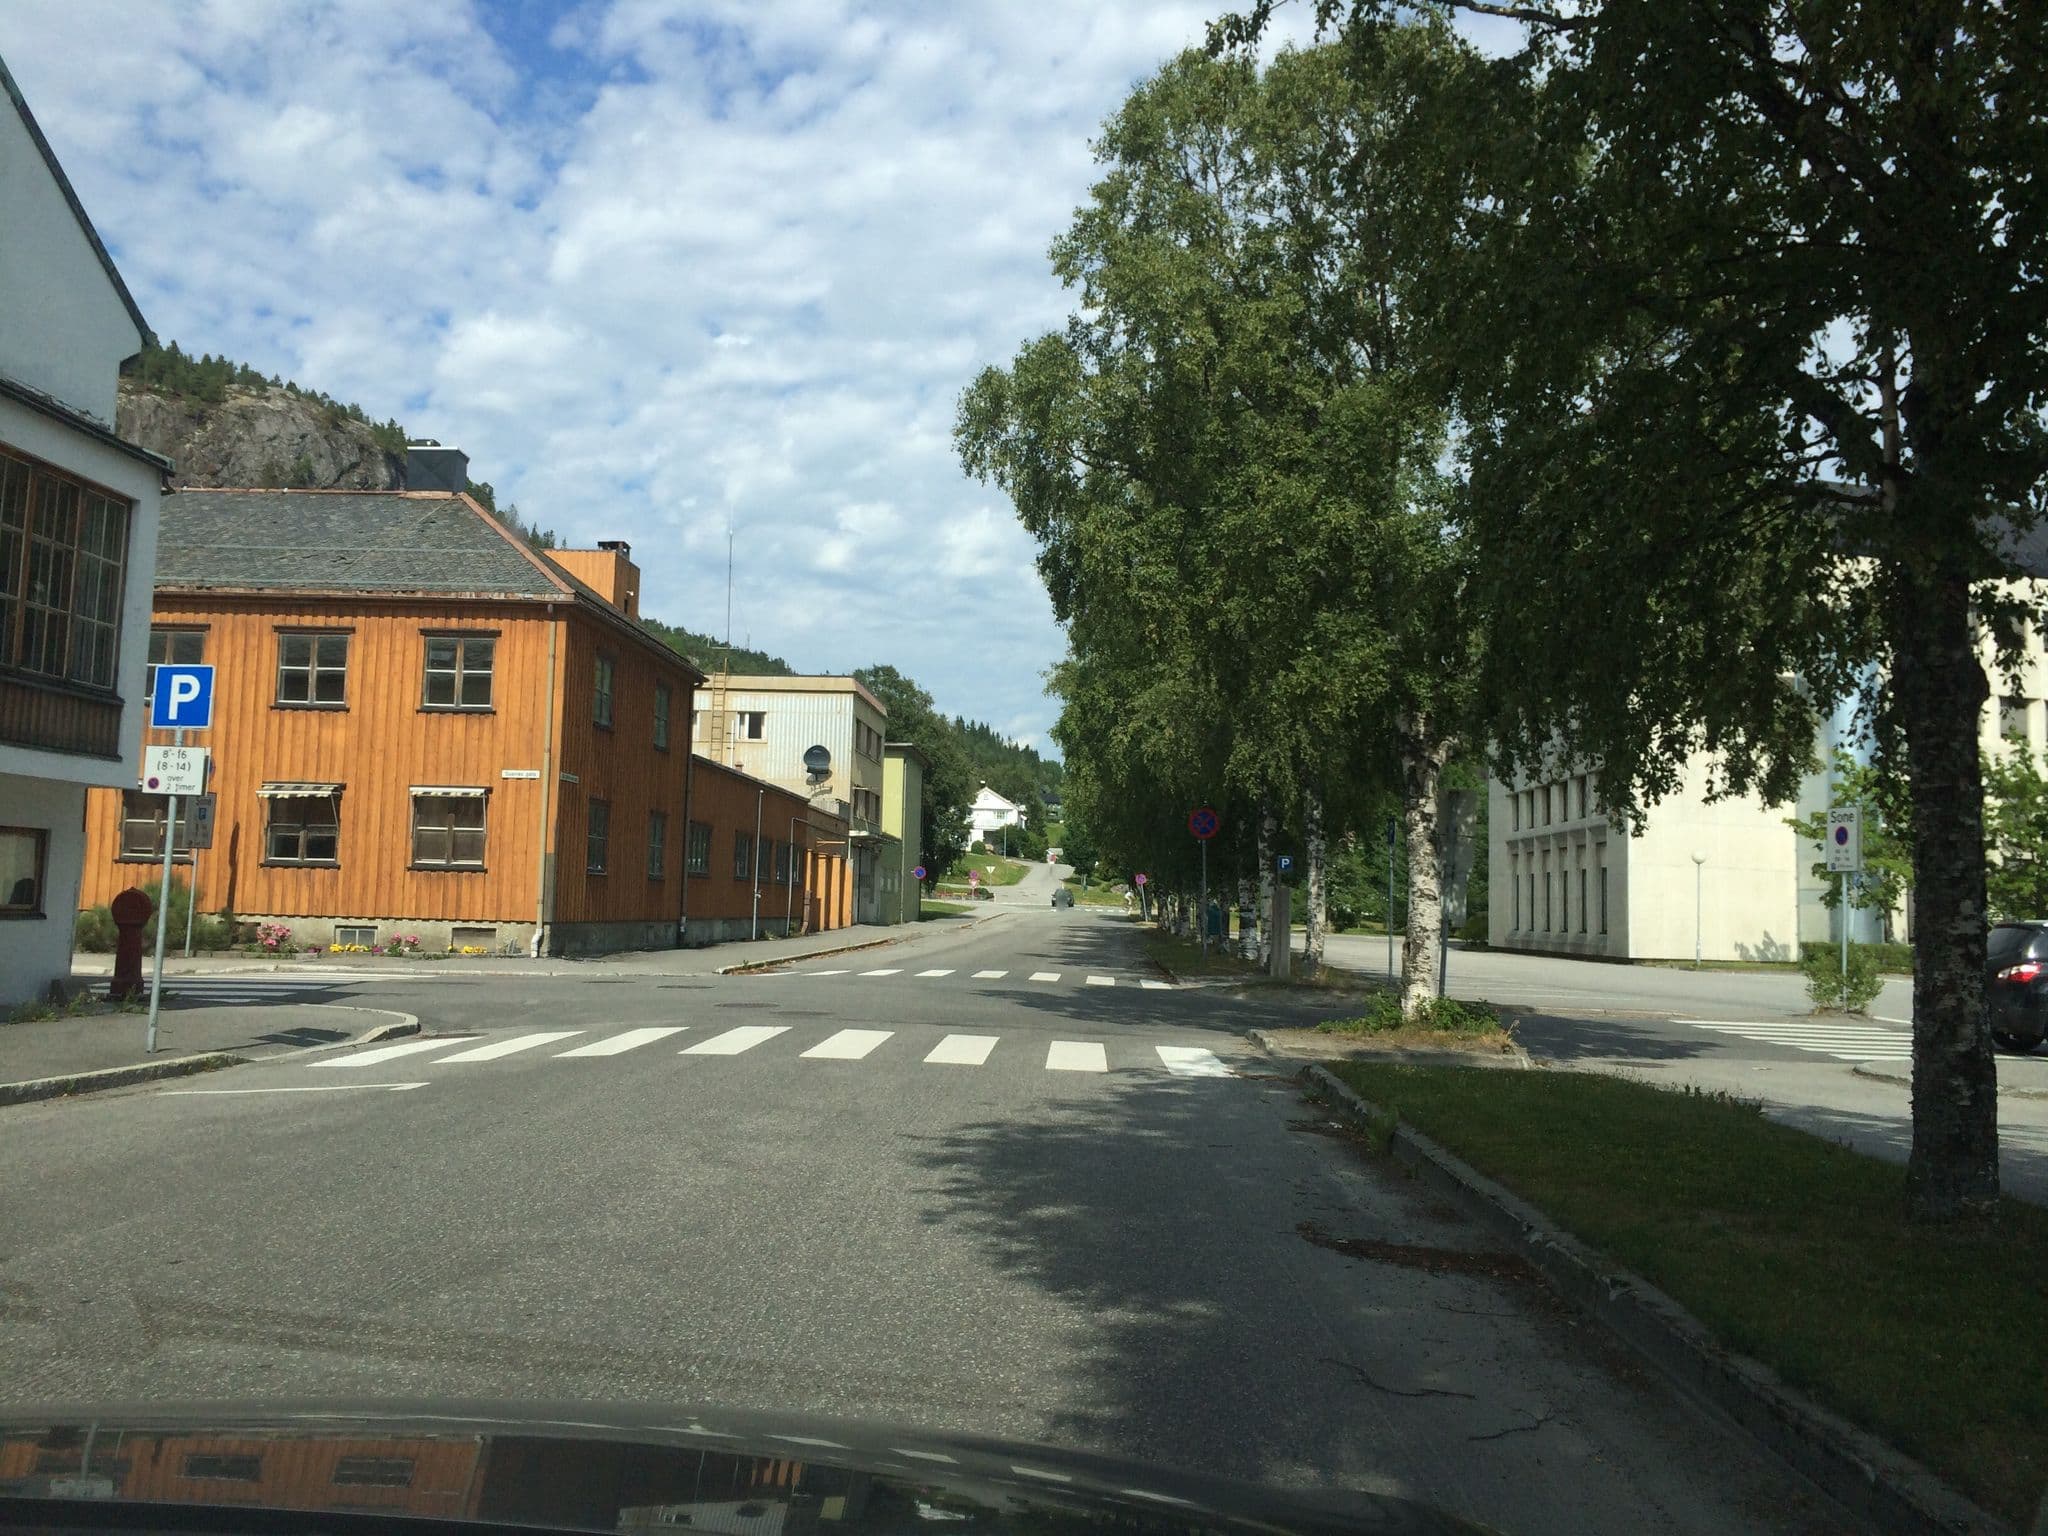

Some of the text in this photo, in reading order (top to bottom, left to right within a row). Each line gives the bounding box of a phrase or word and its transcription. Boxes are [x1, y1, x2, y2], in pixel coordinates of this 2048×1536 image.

[168, 674, 201, 720] P
[1831, 811, 1855, 823] Sone
[1281, 858, 1290, 868] P
